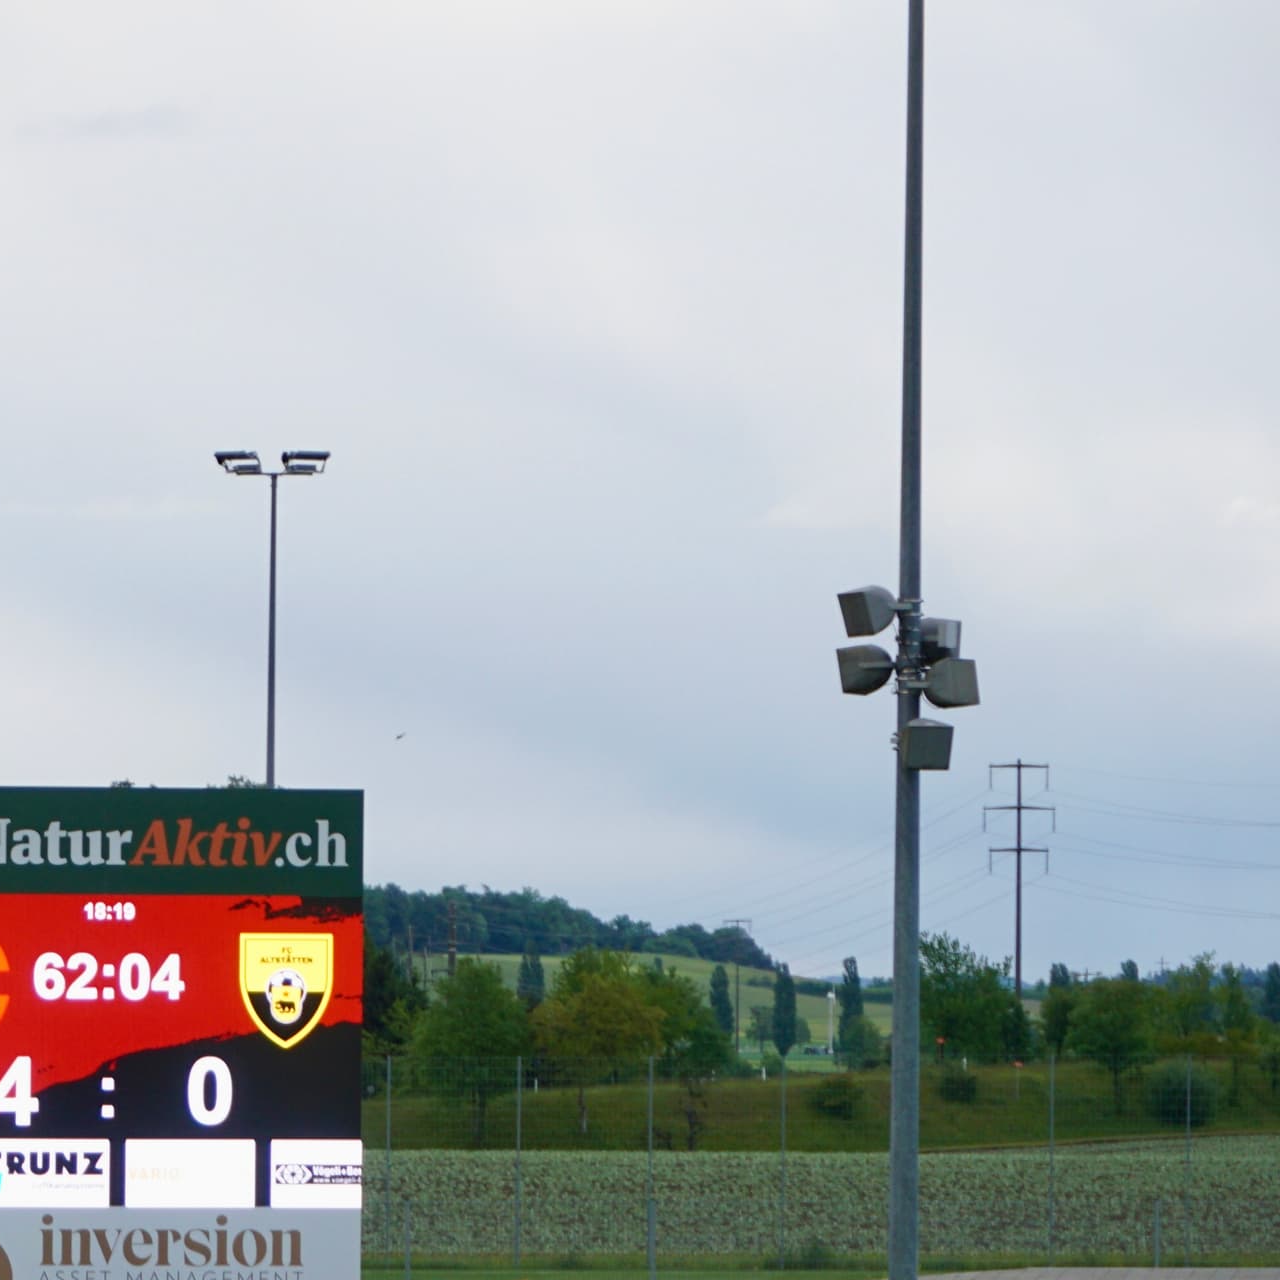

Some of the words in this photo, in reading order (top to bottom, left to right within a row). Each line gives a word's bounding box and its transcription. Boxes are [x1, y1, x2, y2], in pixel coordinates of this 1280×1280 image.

[83, 902, 137, 921] 18:19
[32, 951, 186, 1001] 62:04
[187, 1055, 234, 1126] 0
[40, 1213, 304, 1268] inversion
